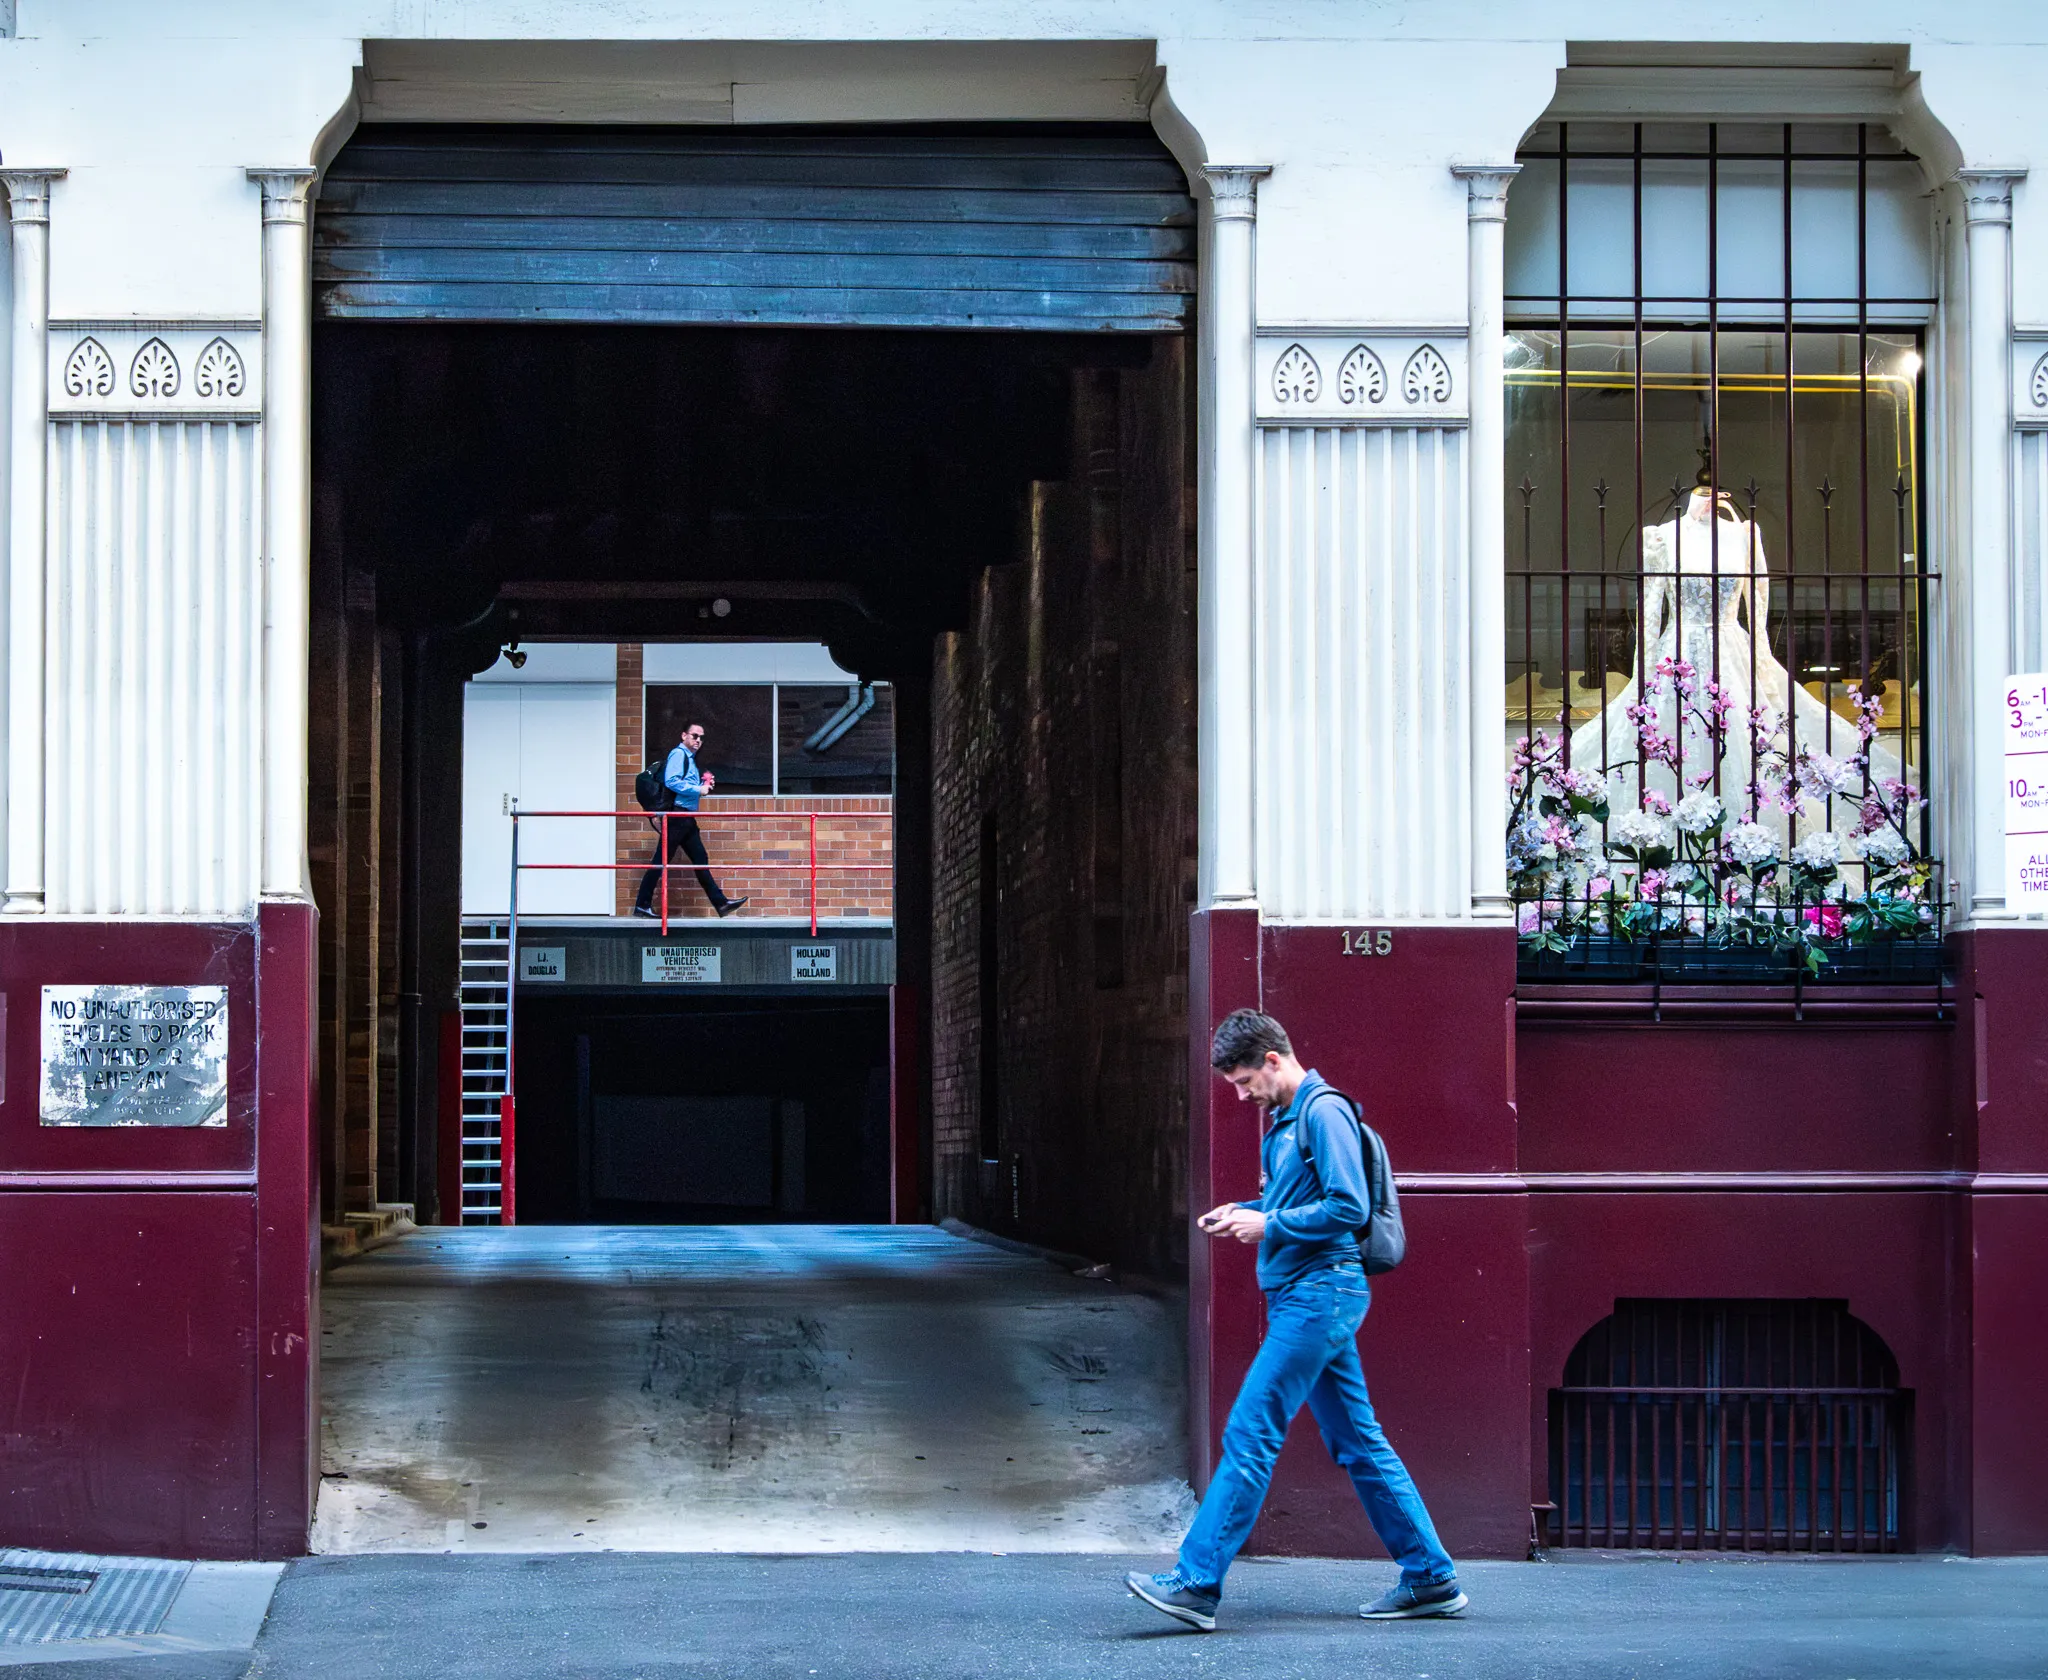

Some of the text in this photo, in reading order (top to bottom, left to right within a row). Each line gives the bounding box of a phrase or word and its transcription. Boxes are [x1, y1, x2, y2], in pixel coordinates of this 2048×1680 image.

[1341, 930, 1392, 956] 145
[646, 947, 717, 957] NO UNAUTHORISED
[796, 949, 831, 958] HOLLAND
[664, 957, 699, 965] VEHICLES
[811, 959, 816, 967] &
[528, 965, 558, 975] DOUGLAS
[796, 968, 831, 977] HOLLAND
[51, 1000, 217, 1020] NO UNAUTHORISED
[50, 1024, 215, 1043] EHICLES TO PARK
[75, 1047, 183, 1067] IN YARD OR
